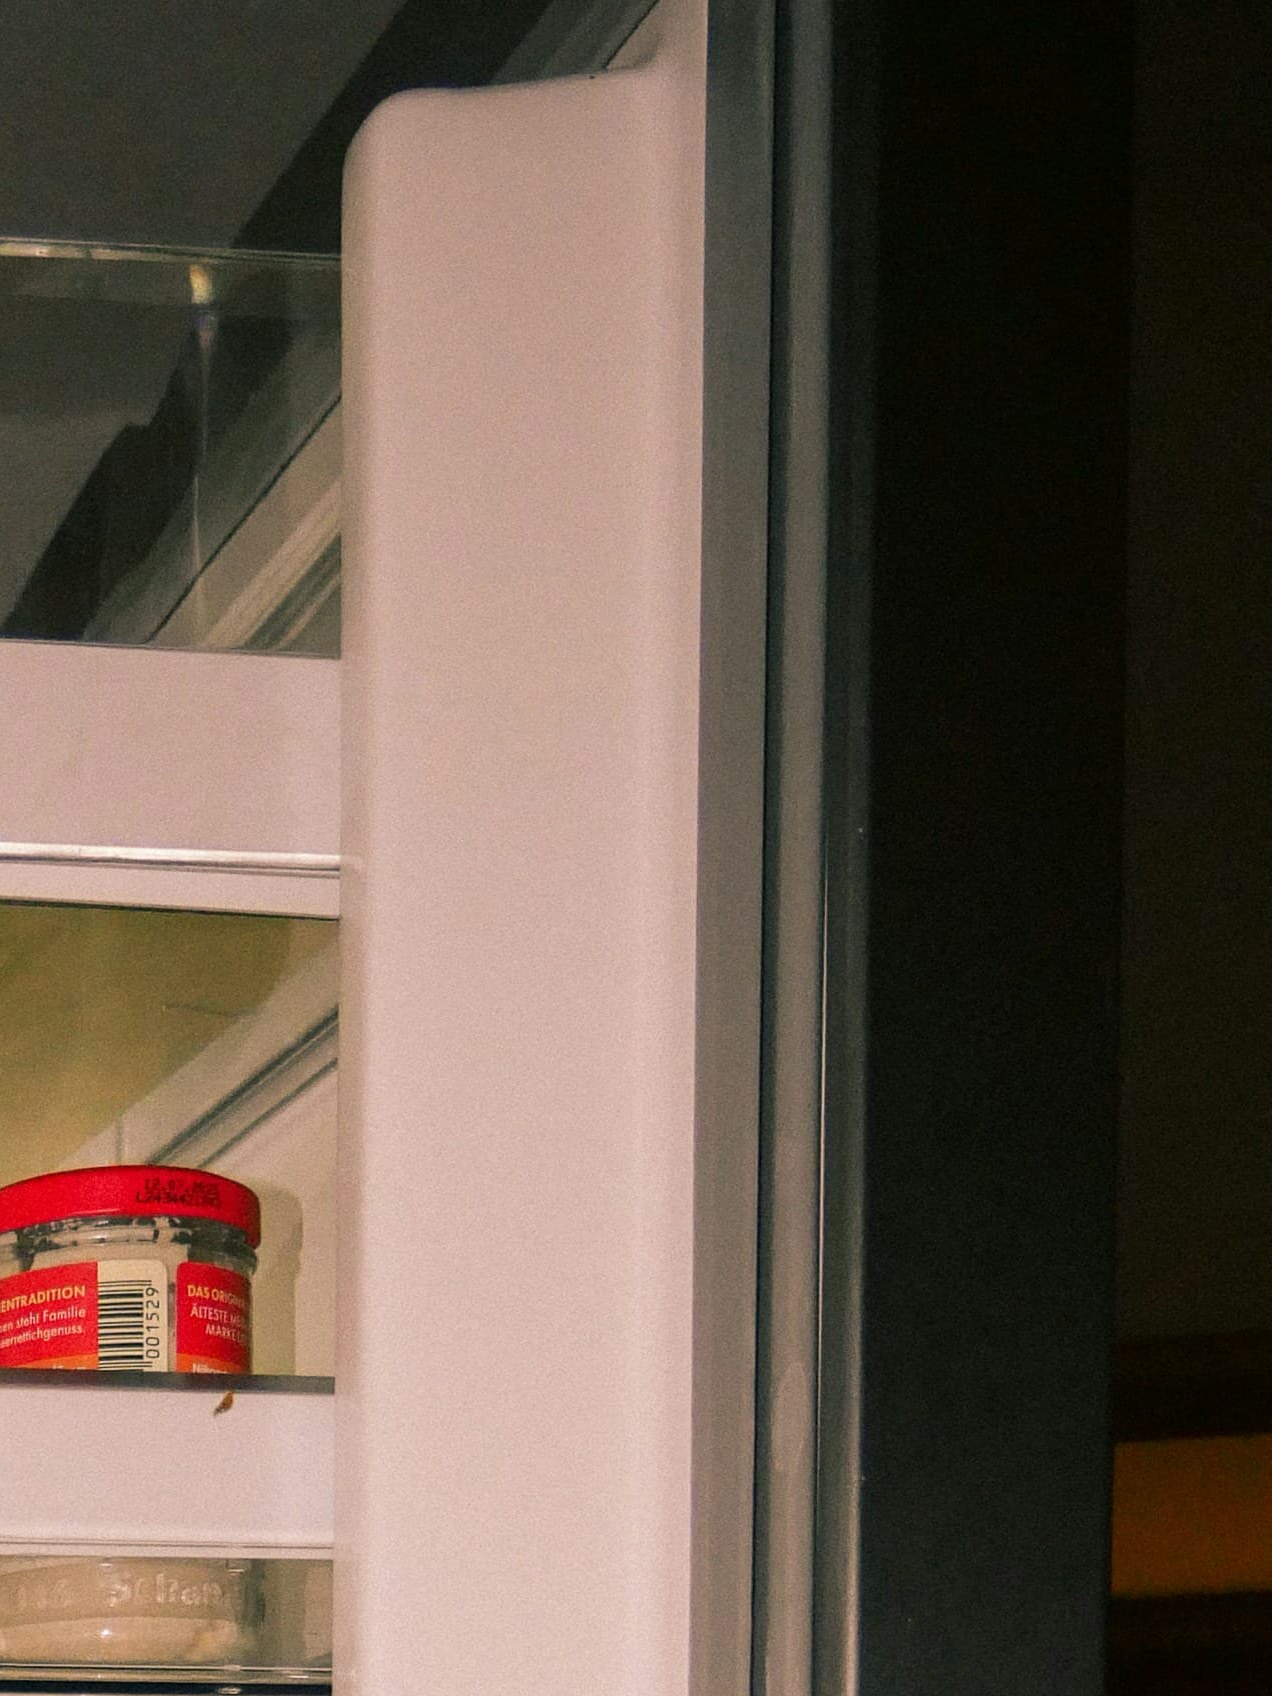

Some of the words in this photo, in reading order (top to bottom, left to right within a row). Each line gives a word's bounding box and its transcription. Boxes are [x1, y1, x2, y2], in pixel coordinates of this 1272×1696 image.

[187, 1284, 210, 1300] DAS
[17, 1312, 39, 1329] steht
[43, 1305, 86, 1323] Familie
[145, 1287, 160, 1359] 001529
